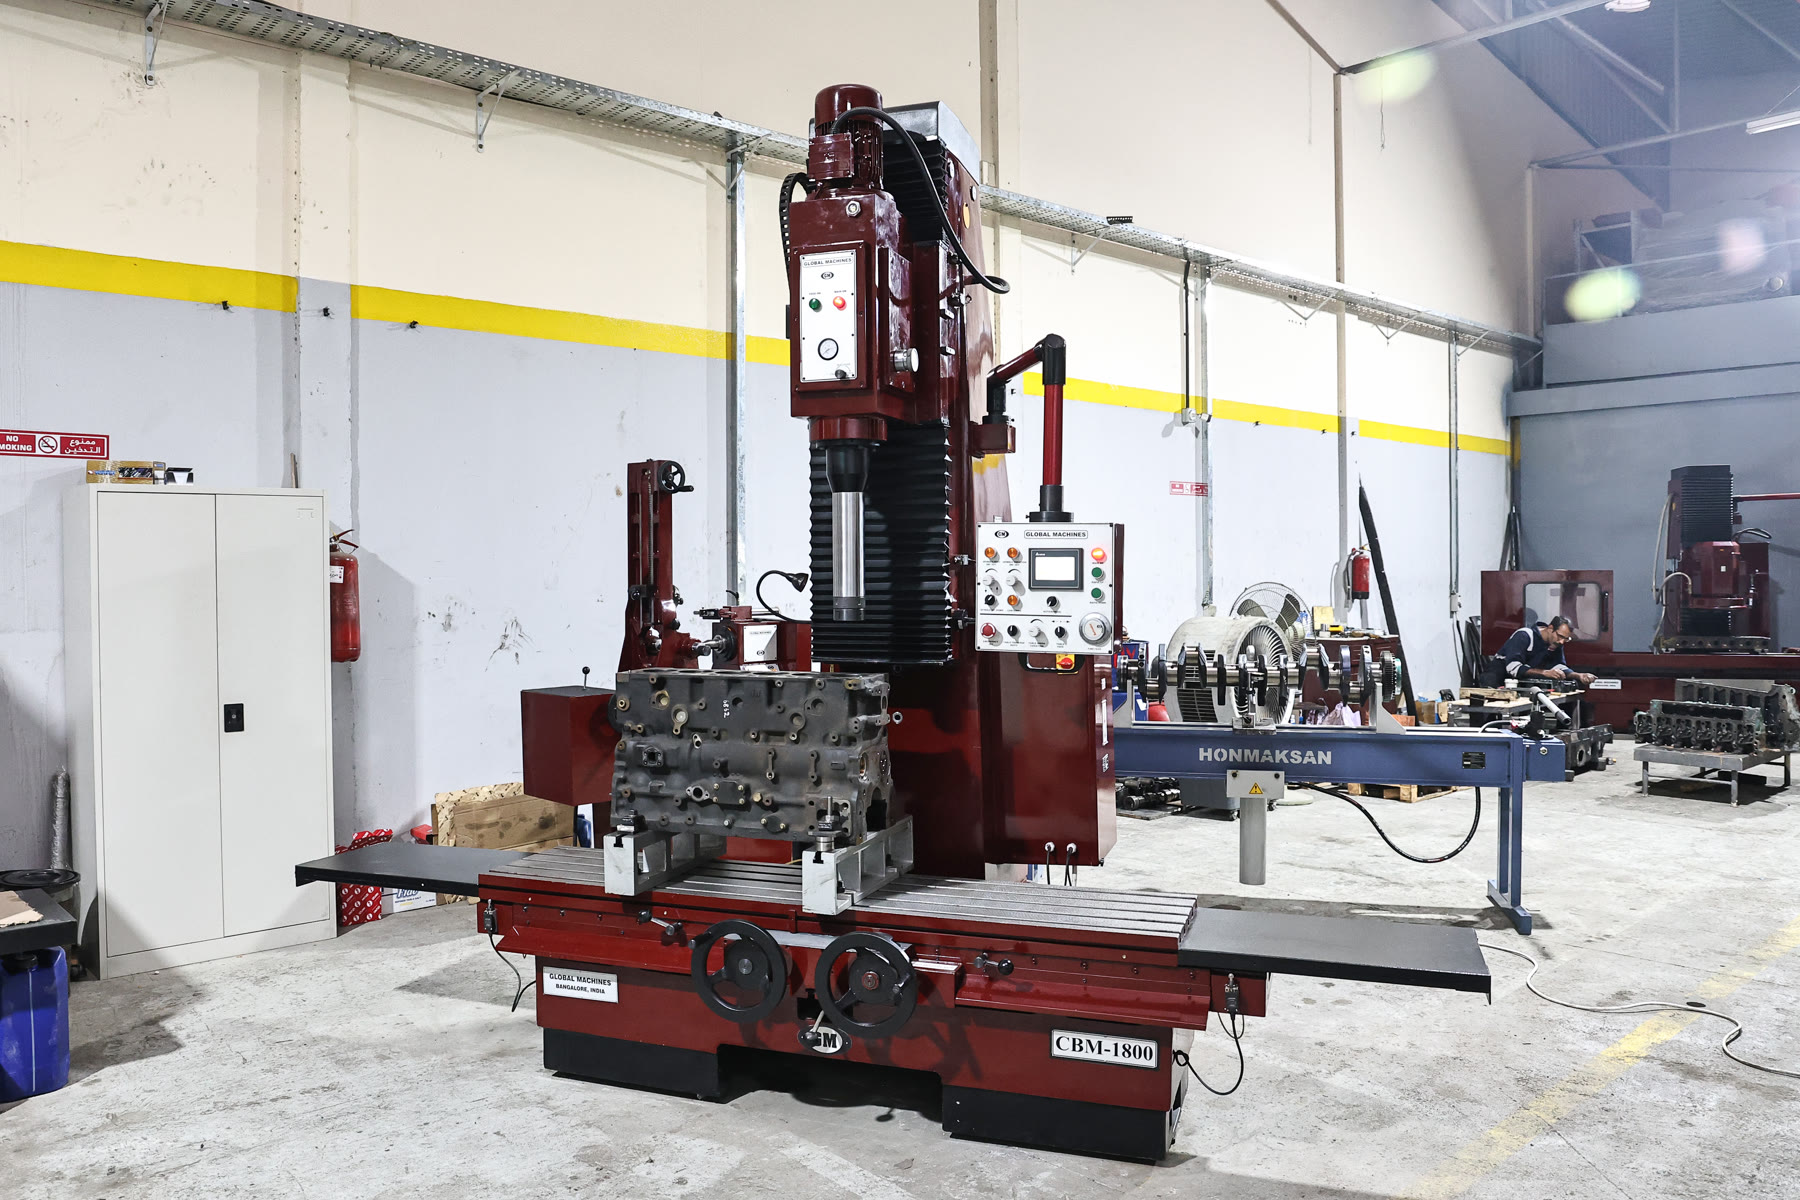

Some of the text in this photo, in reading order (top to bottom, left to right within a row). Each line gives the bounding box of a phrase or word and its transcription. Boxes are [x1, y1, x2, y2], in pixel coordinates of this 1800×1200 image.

[0, 443, 33, 451] MOKING
[69, 438, 96, 447] ممنوع
[64, 446, 101, 454] التدخين
[1199, 747, 1332, 765] HONMAKSAN
[549, 973, 612, 986] GLOBAL MACHINES
[555, 983, 590, 993] BANGALORE,
[1055, 1035, 1153, 1061] CBM-1800
